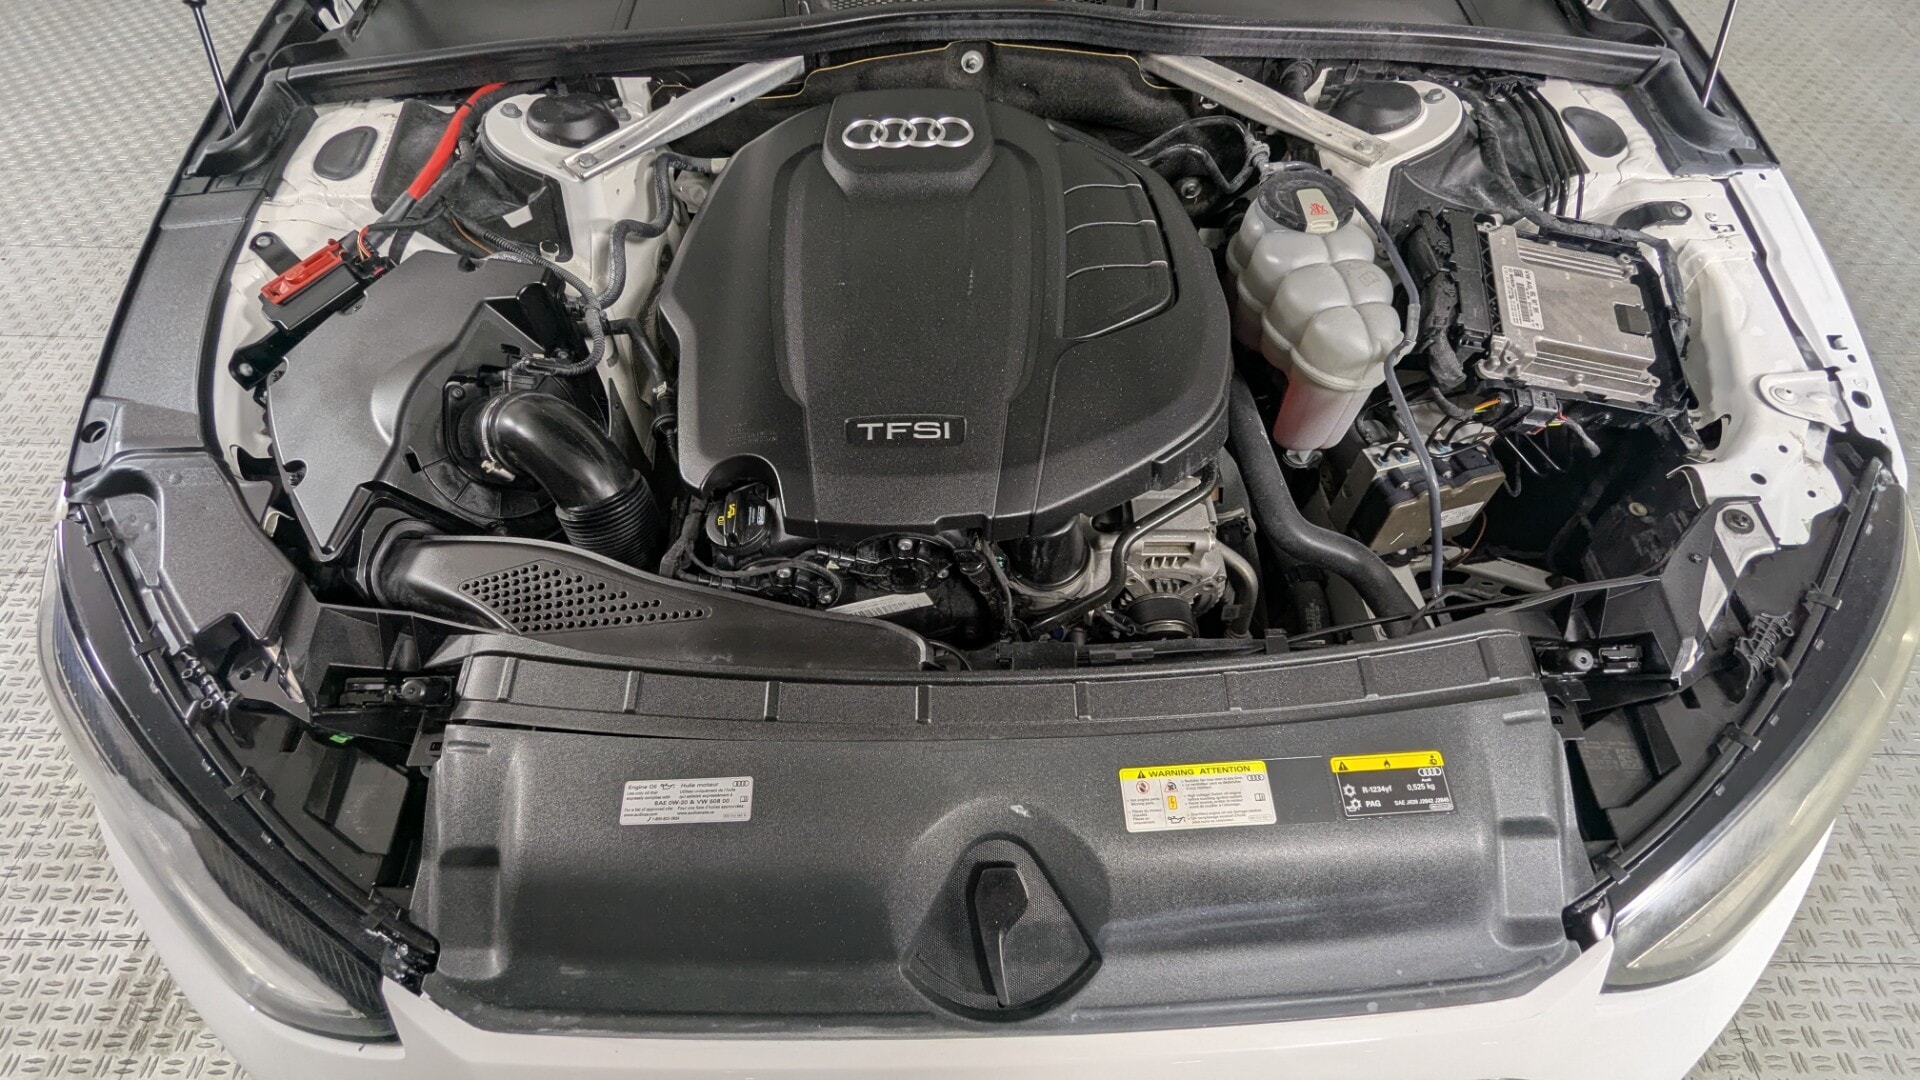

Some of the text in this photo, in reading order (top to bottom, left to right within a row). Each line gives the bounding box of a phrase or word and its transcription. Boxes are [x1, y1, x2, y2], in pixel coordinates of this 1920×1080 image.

[856, 422, 950, 440] TFSI
[1149, 765, 1251, 778] WARNING ATTENTION
[1362, 785, 1392, 794] R-1234yf
[1426, 783, 1436, 791] kg
